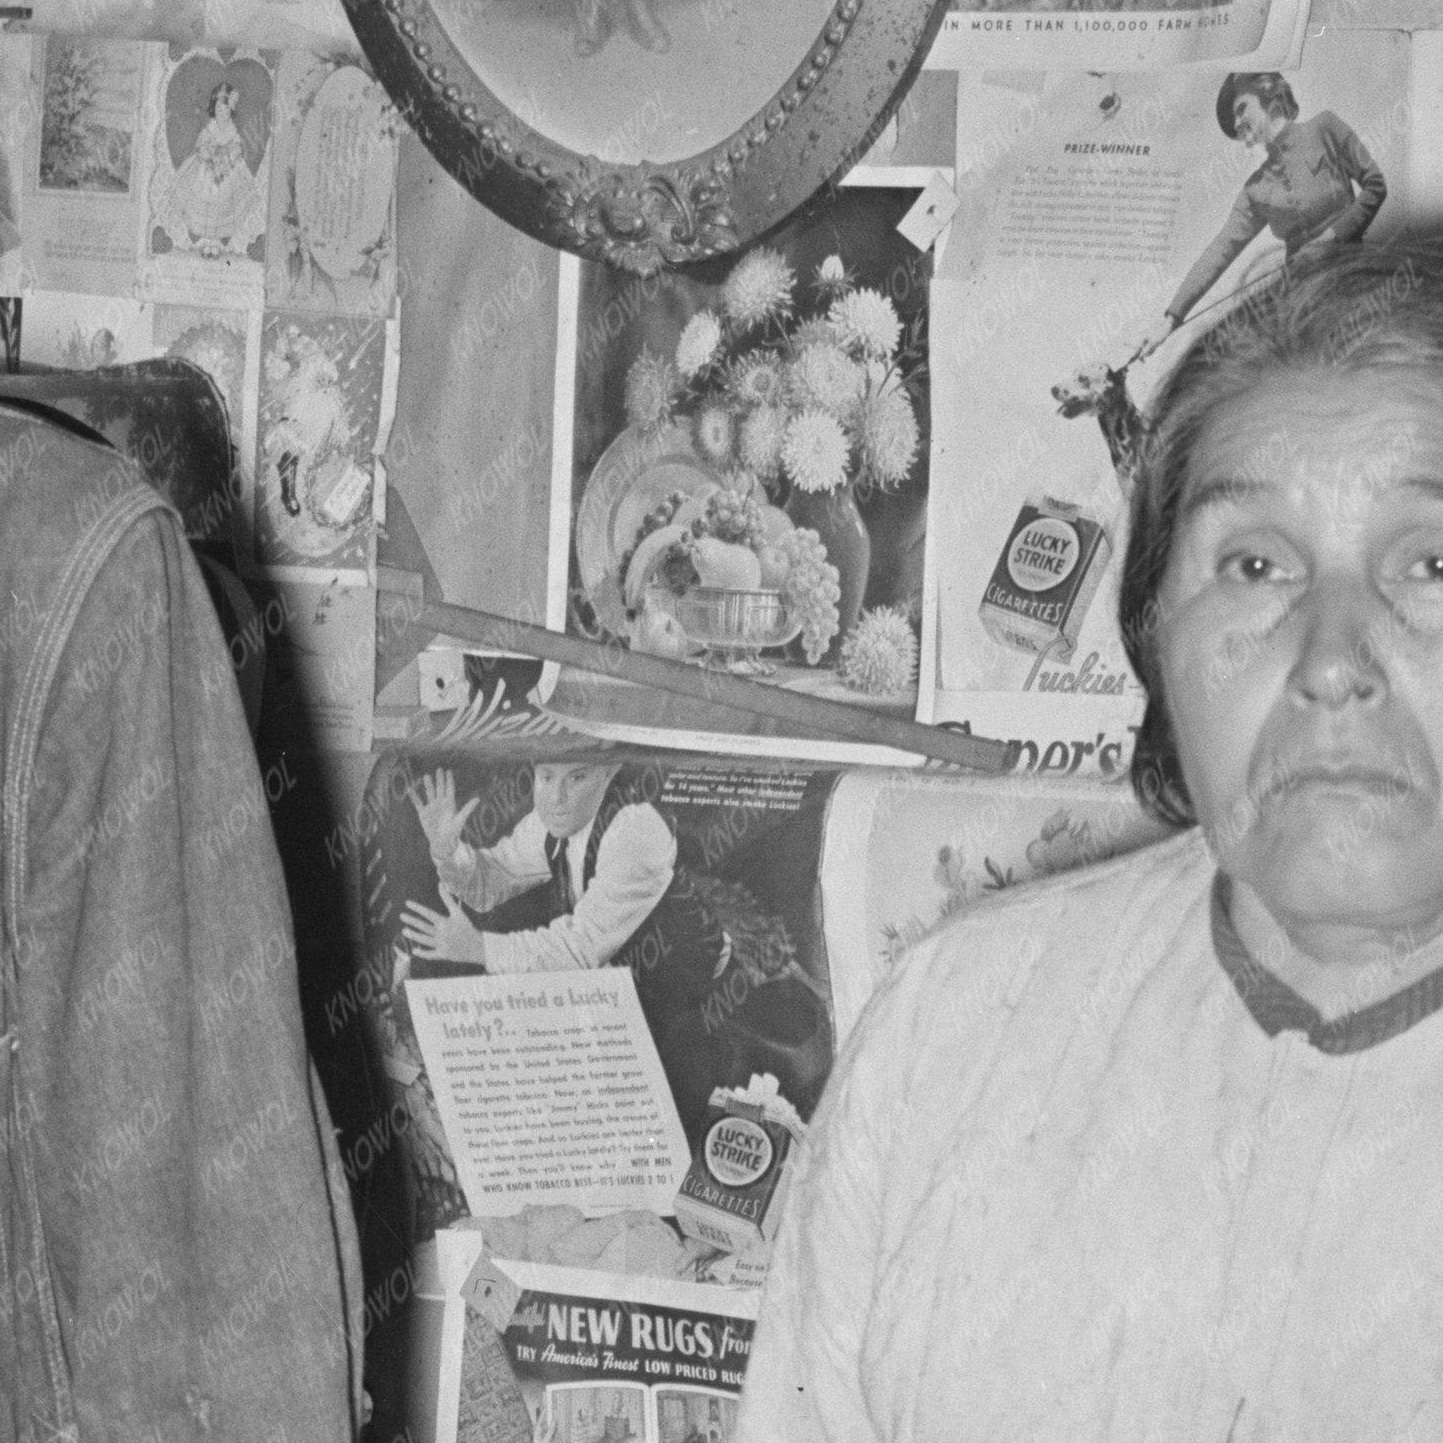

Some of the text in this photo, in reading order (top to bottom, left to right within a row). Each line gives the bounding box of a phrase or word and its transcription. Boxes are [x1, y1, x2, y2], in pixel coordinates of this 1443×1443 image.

[944, 19, 959, 32] IN
[971, 19, 1013, 31] MORE
[1025, 19, 1065, 31] THAN
[1074, 19, 1148, 33] 1,100,000
[1158, 18, 1191, 31] FARM
[1064, 142, 1150, 156] PRIZE-WINNER
[1022, 529, 1073, 556] LUCKY
[1013, 547, 1066, 577] STRIKE
[985, 581, 1063, 624] CIGARETTES
[425, 987, 619, 1018] Have you tried a Lucky
[526, 1028, 559, 1039] Tobacco
[524, 1059, 551, 1069] United
[556, 1057, 582, 1067] States
[718, 1126, 765, 1150] LUCKY
[631, 1156, 671, 1168] WITH MEN
[711, 1141, 763, 1172] STRIKE
[483, 1174, 667, 1194] WHO KNOW TOBACCO LUCKIES TO
[683, 1174, 760, 1219] CIGARETTES
[729, 1273, 763, 1288] Because
[548, 1304, 714, 1359] NEW RUGS
[517, 1343, 717, 1382] TRY America's Finest LOW PRICED
